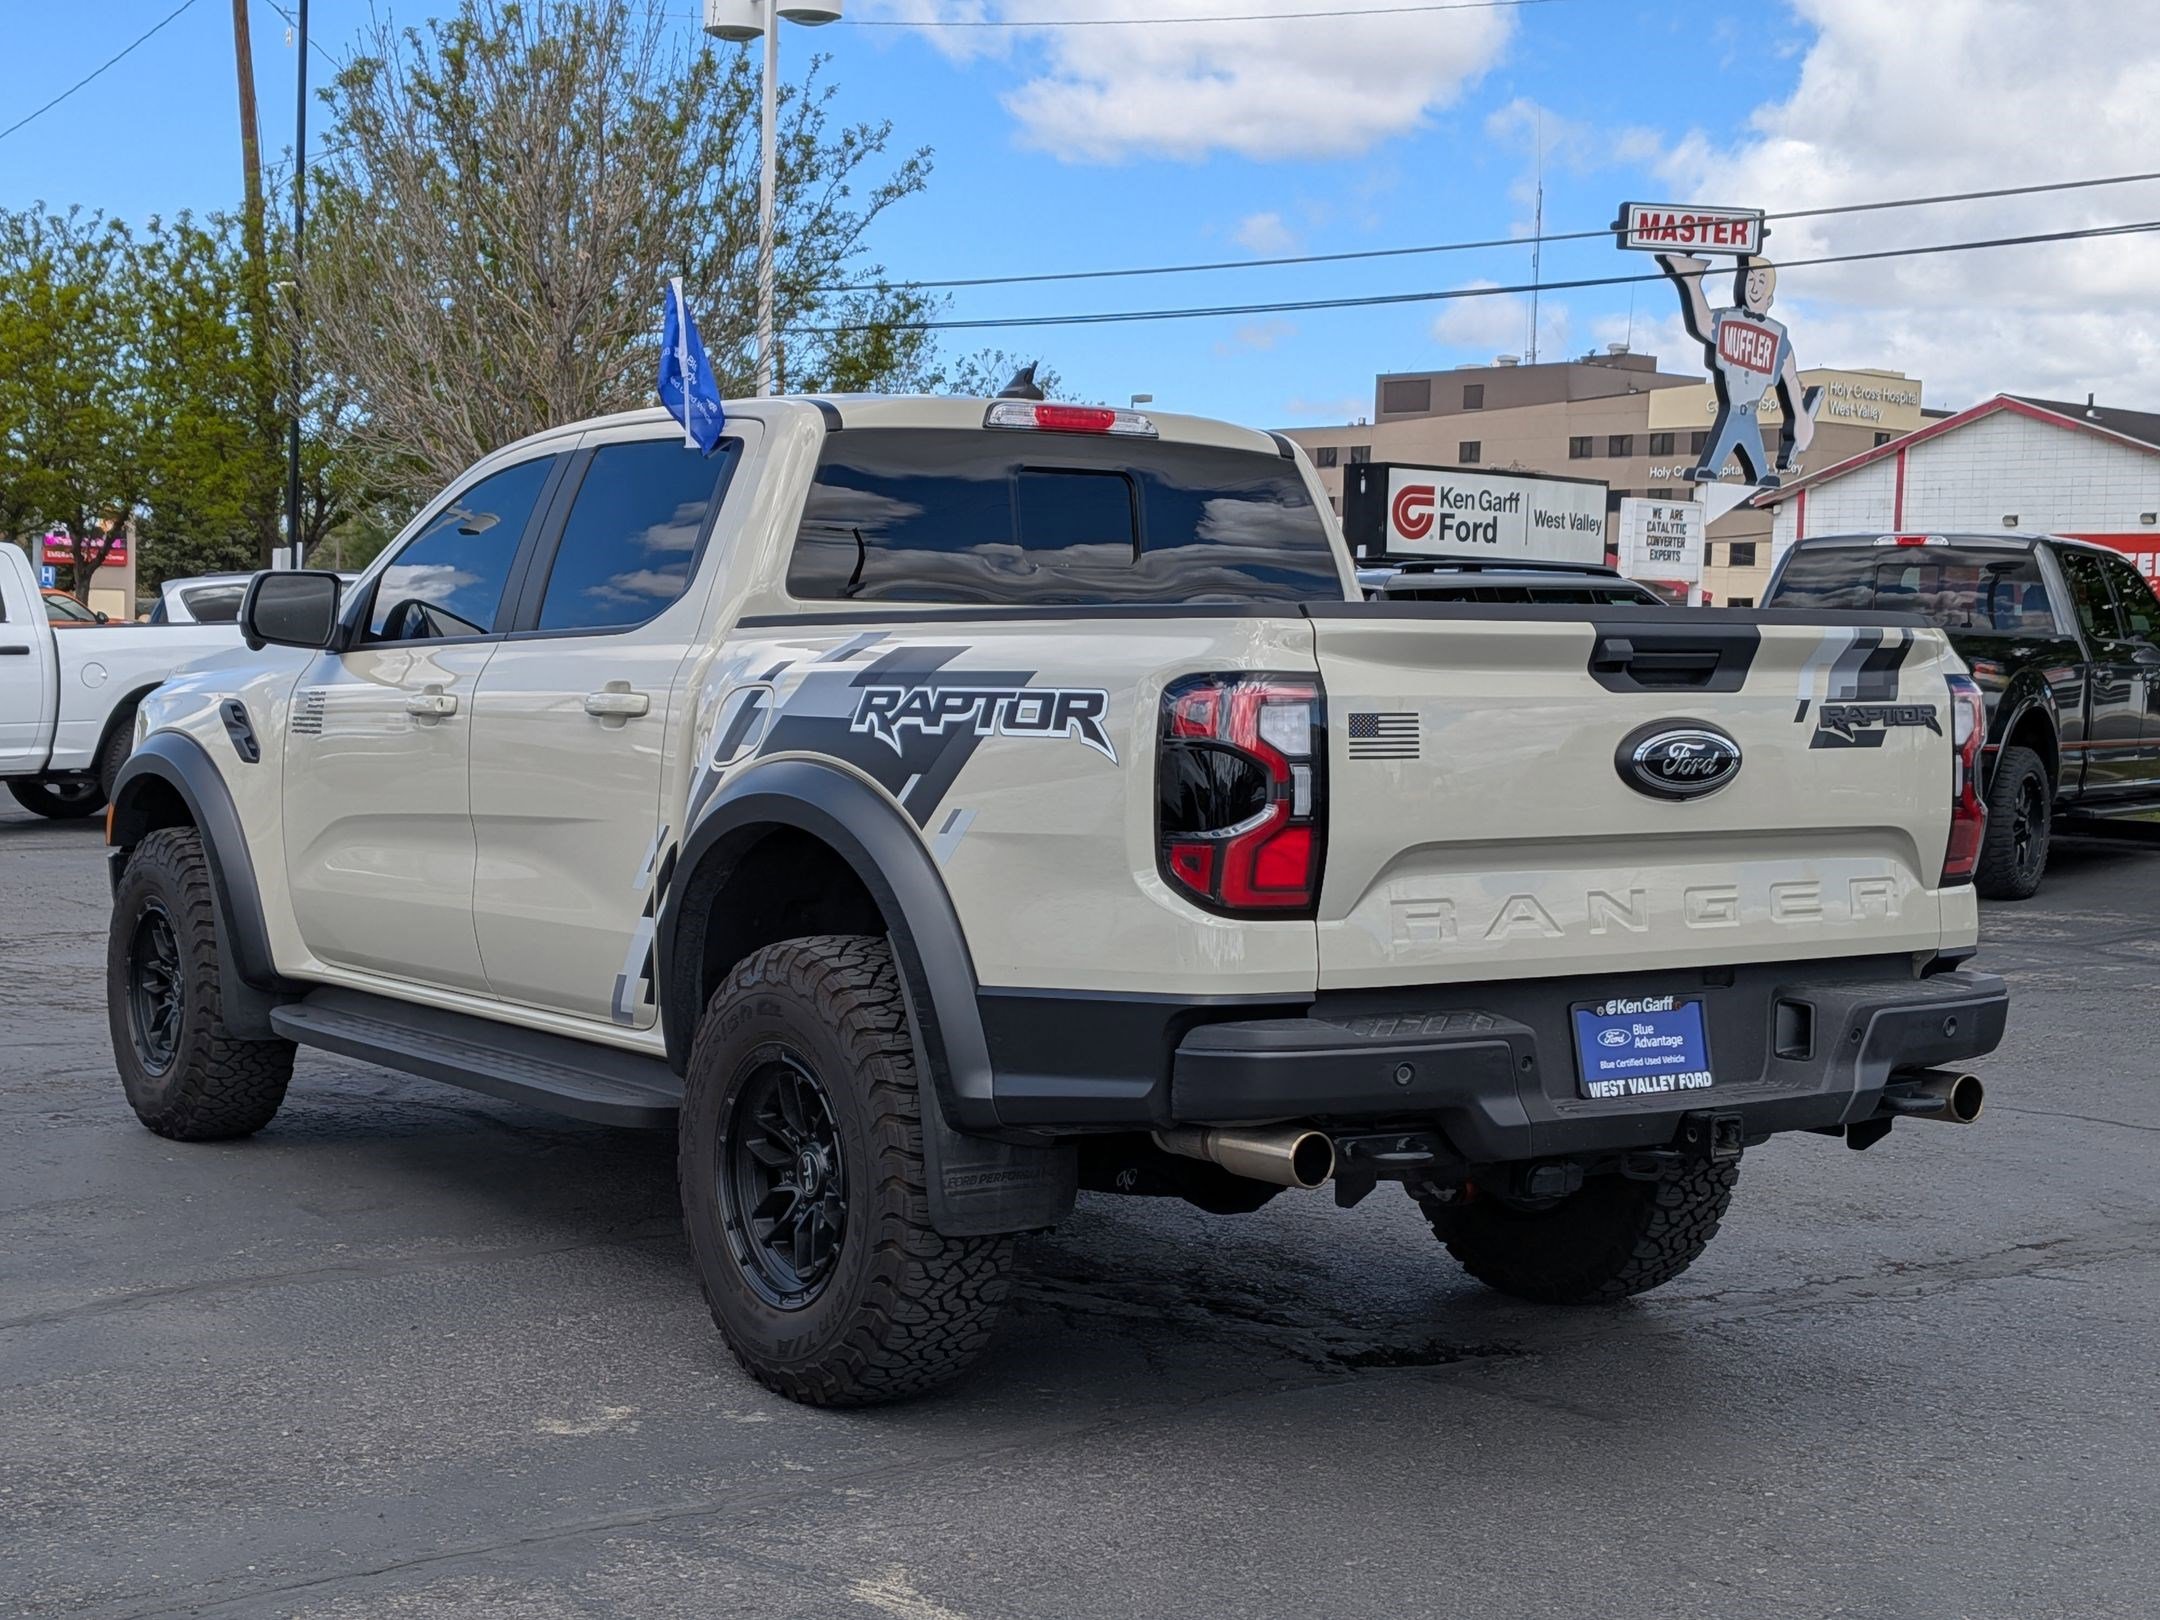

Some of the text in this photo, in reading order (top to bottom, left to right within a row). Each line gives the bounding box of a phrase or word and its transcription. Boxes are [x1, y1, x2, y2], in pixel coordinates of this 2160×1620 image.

[1638, 213, 1749, 245] MASTER
[1724, 326, 1772, 369] MUFFLER
[1829, 382, 1919, 405] Holy Cross Hospital
[1829, 401, 1884, 421] West Valley
[1650, 466, 1671, 479] Holy
[1439, 486, 1520, 514] Ken Garff
[1533, 509, 1602, 536] West Valley
[1652, 508, 1684, 520] WE ARE
[1439, 513, 1498, 544] Ford
[1646, 521, 1687, 535] CATALYTIC
[1646, 535, 1686, 548] CONVERTER
[1650, 549, 1681, 561] EXPERTS
[850, 685, 1119, 767] RAPTOR
[1819, 704, 1943, 739] RAPTOR
[1662, 743, 1719, 775] Ford
[1391, 876, 1899, 943] RANGER
[1617, 996, 1674, 1014] Ken Garff
[1603, 1030, 1626, 1044] Ford
[1633, 1024, 1654, 1035] Blue
[1634, 1035, 1683, 1049] Advantage
[1600, 1055, 1685, 1069] Blue Certified Used Vehicle
[1588, 1071, 1712, 1098] WEST VALLEY FORD
